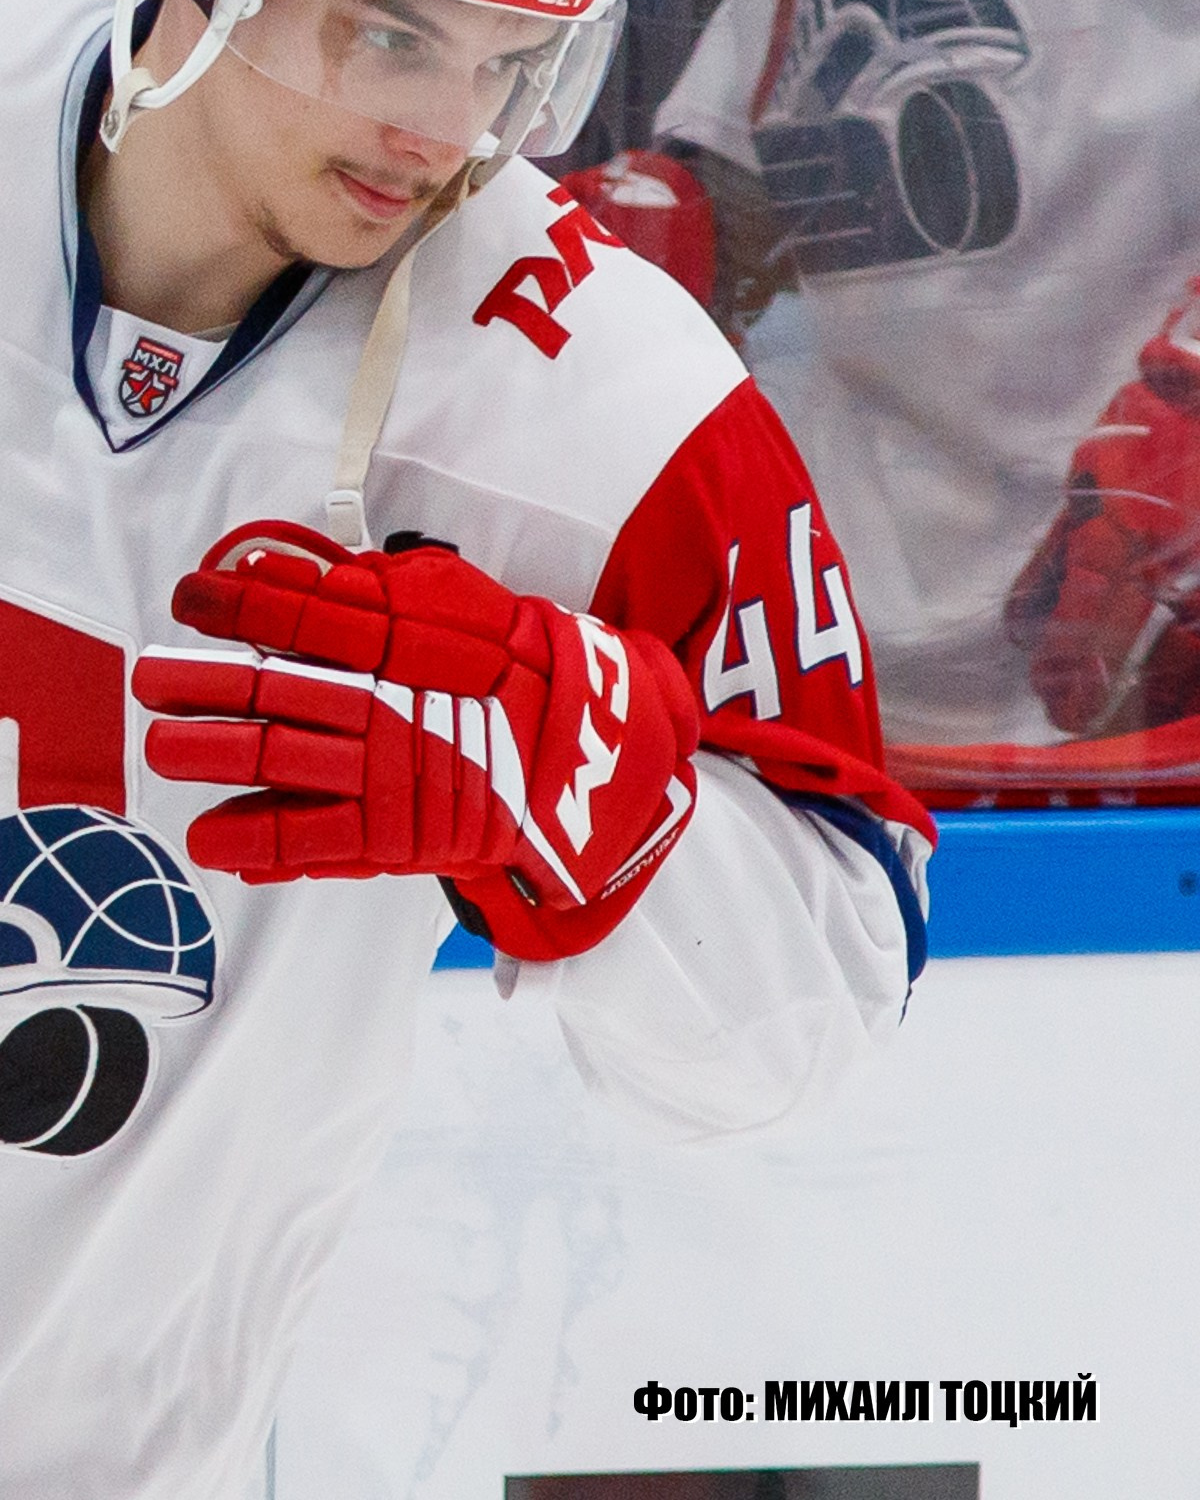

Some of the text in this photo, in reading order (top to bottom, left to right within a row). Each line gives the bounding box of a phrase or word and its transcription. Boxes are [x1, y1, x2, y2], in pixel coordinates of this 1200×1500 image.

[133, 347, 178, 378] МХЛ
[701, 502, 864, 724] 44
[554, 602, 631, 857] CM
